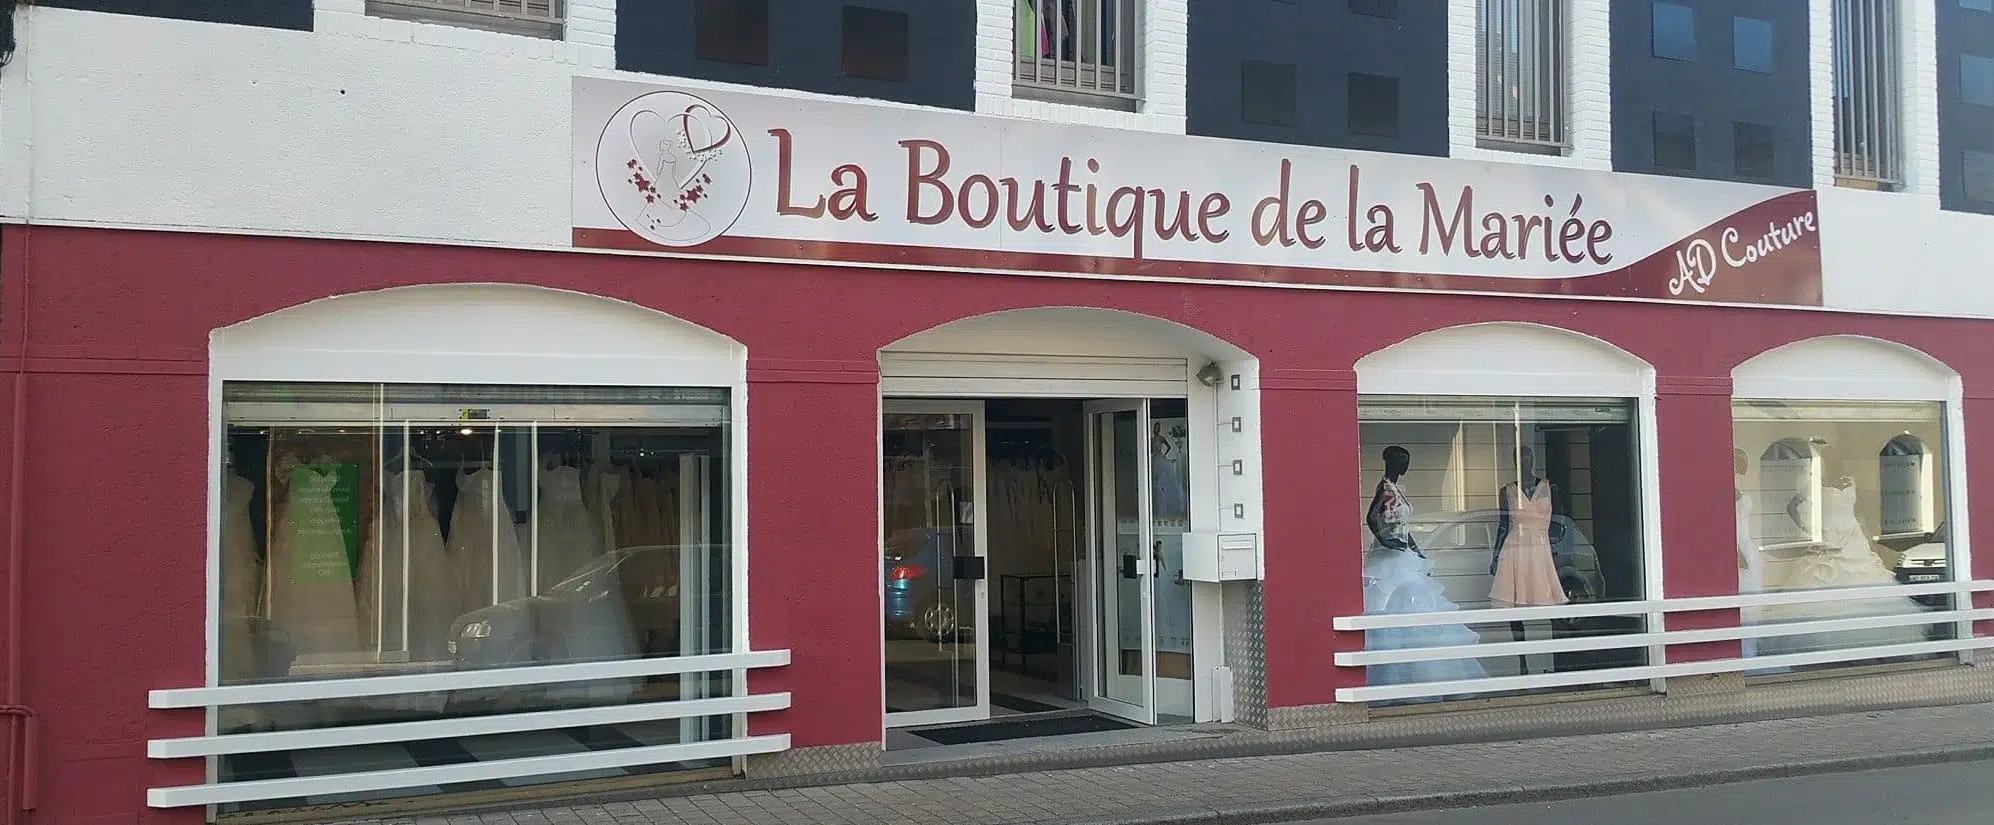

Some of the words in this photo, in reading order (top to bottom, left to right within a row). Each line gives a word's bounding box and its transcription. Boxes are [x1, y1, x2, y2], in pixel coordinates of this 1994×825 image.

[767, 129, 878, 222] La
[898, 139, 1231, 259] Boutique
[1251, 158, 1327, 249] de
[1347, 164, 1402, 254] la
[1415, 182, 1613, 266] Mariée
[1668, 238, 1717, 295] AD
[1720, 210, 1817, 268] Couture
